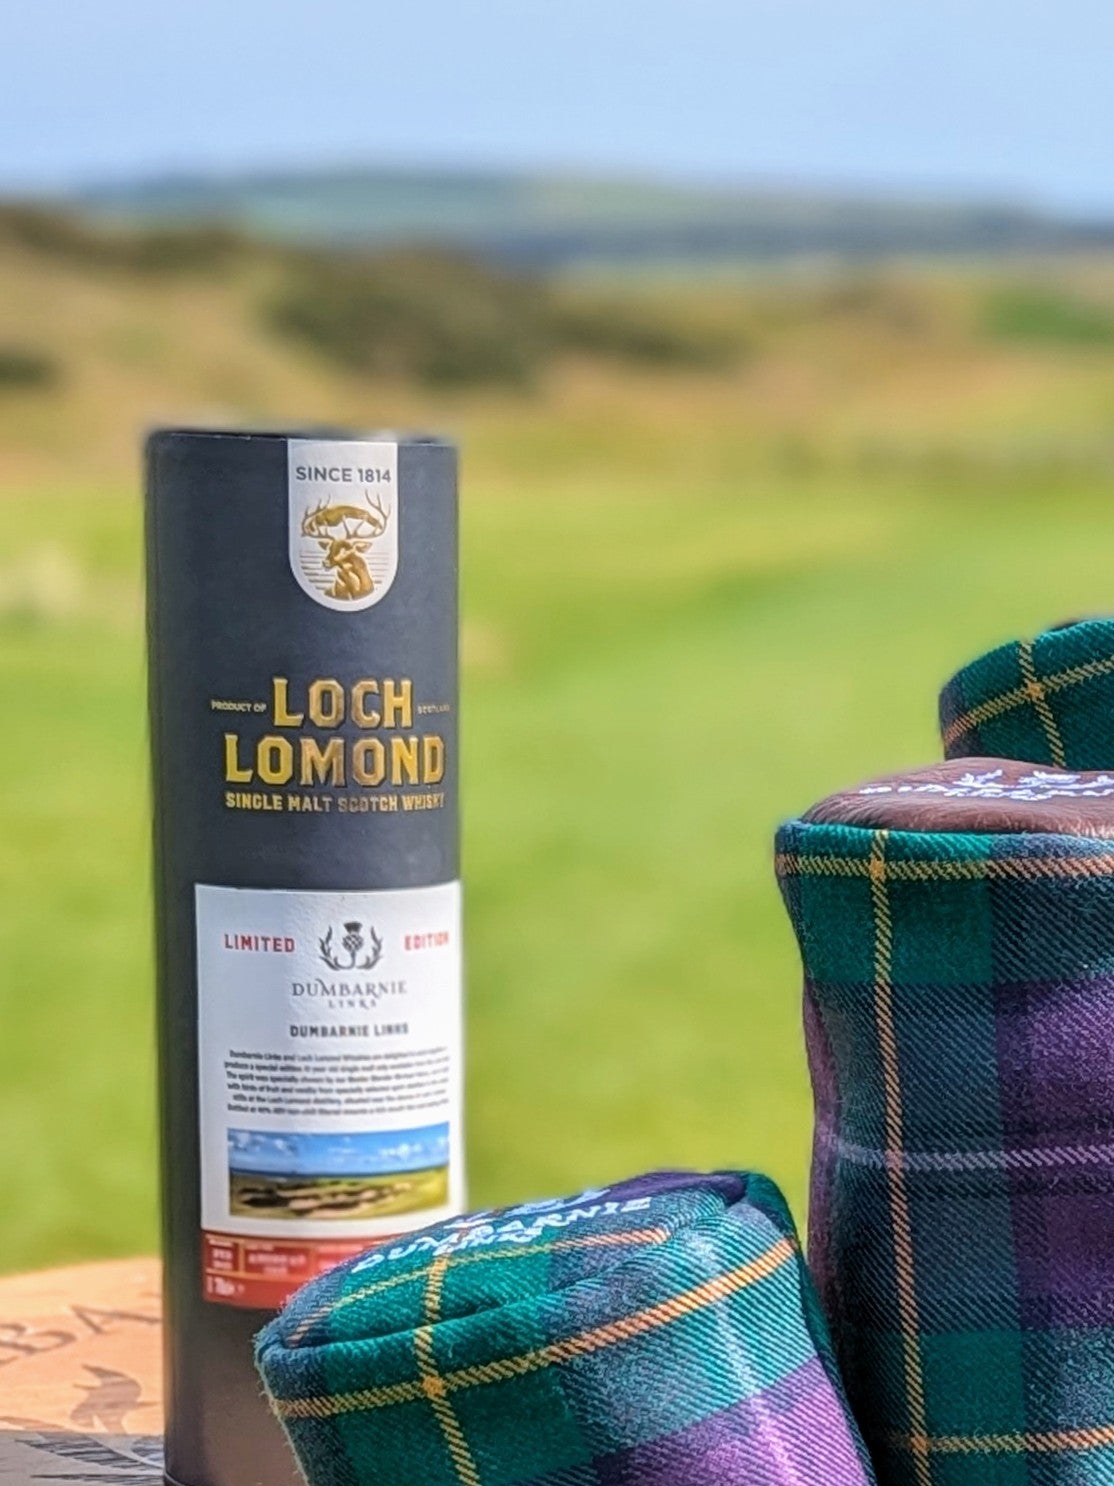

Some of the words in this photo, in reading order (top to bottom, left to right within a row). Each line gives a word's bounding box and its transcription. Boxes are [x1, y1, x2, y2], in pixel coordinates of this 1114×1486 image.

[295, 466, 353, 482] SINCE
[357, 468, 391, 483] 1814
[272, 677, 413, 729] LOCH
[224, 733, 445, 787] LOMOND
[225, 792, 284, 812] SINGLE
[287, 794, 333, 813] MALT
[337, 795, 399, 814] SCOTCH
[401, 791, 445, 811] WHISKY
[224, 933, 296, 953] LIMITED
[404, 931, 449, 951] EDITION
[292, 978, 408, 999] DUMBARNIE
[328, 999, 378, 1010] LINKS
[289, 1024, 369, 1038] DUMBARNIE
[373, 1022, 409, 1037] LINKS
